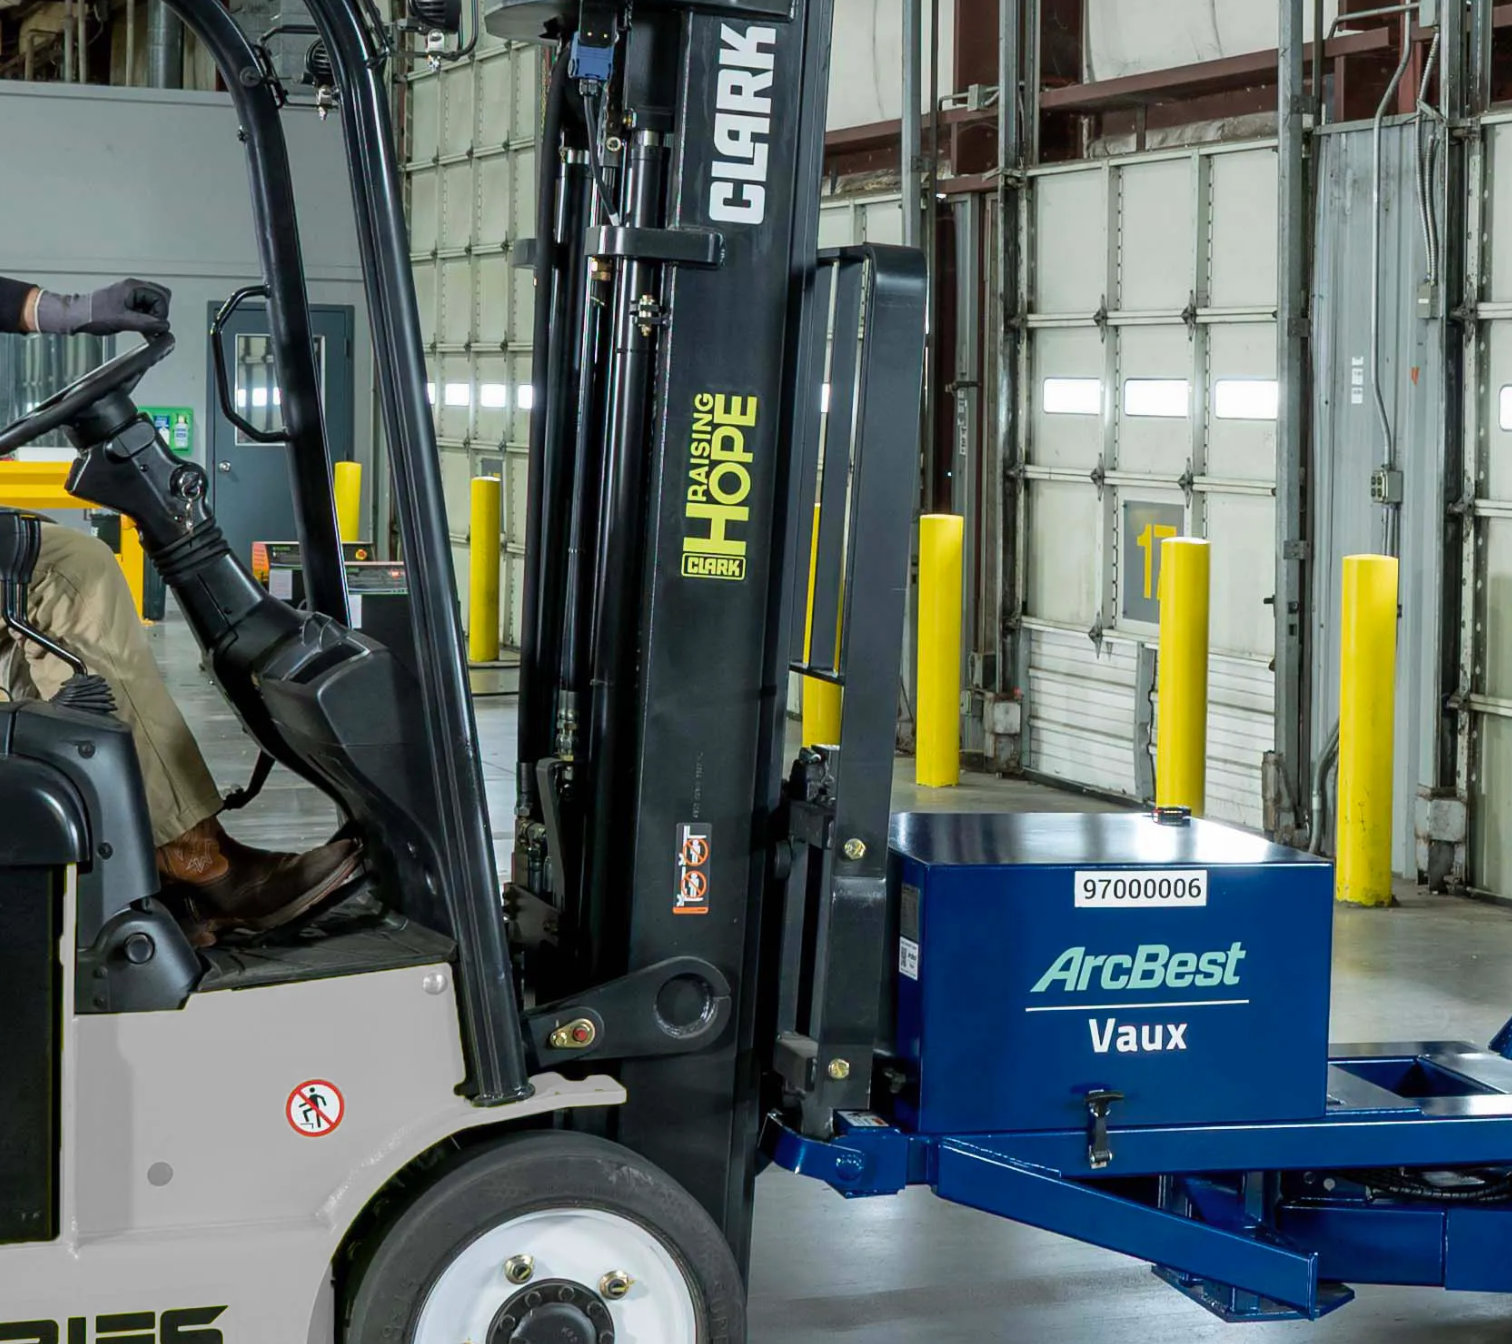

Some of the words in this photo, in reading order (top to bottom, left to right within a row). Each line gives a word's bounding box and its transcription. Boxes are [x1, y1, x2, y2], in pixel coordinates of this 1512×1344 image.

[709, 22, 776, 224] CLARK
[687, 392, 714, 503] RAISING
[683, 394, 758, 555] HOPE
[686, 557, 741, 576] CLARK
[1082, 877, 1202, 902] 97000006
[1030, 940, 1247, 993] ArcBest
[1088, 1018, 1188, 1053] Vaux
